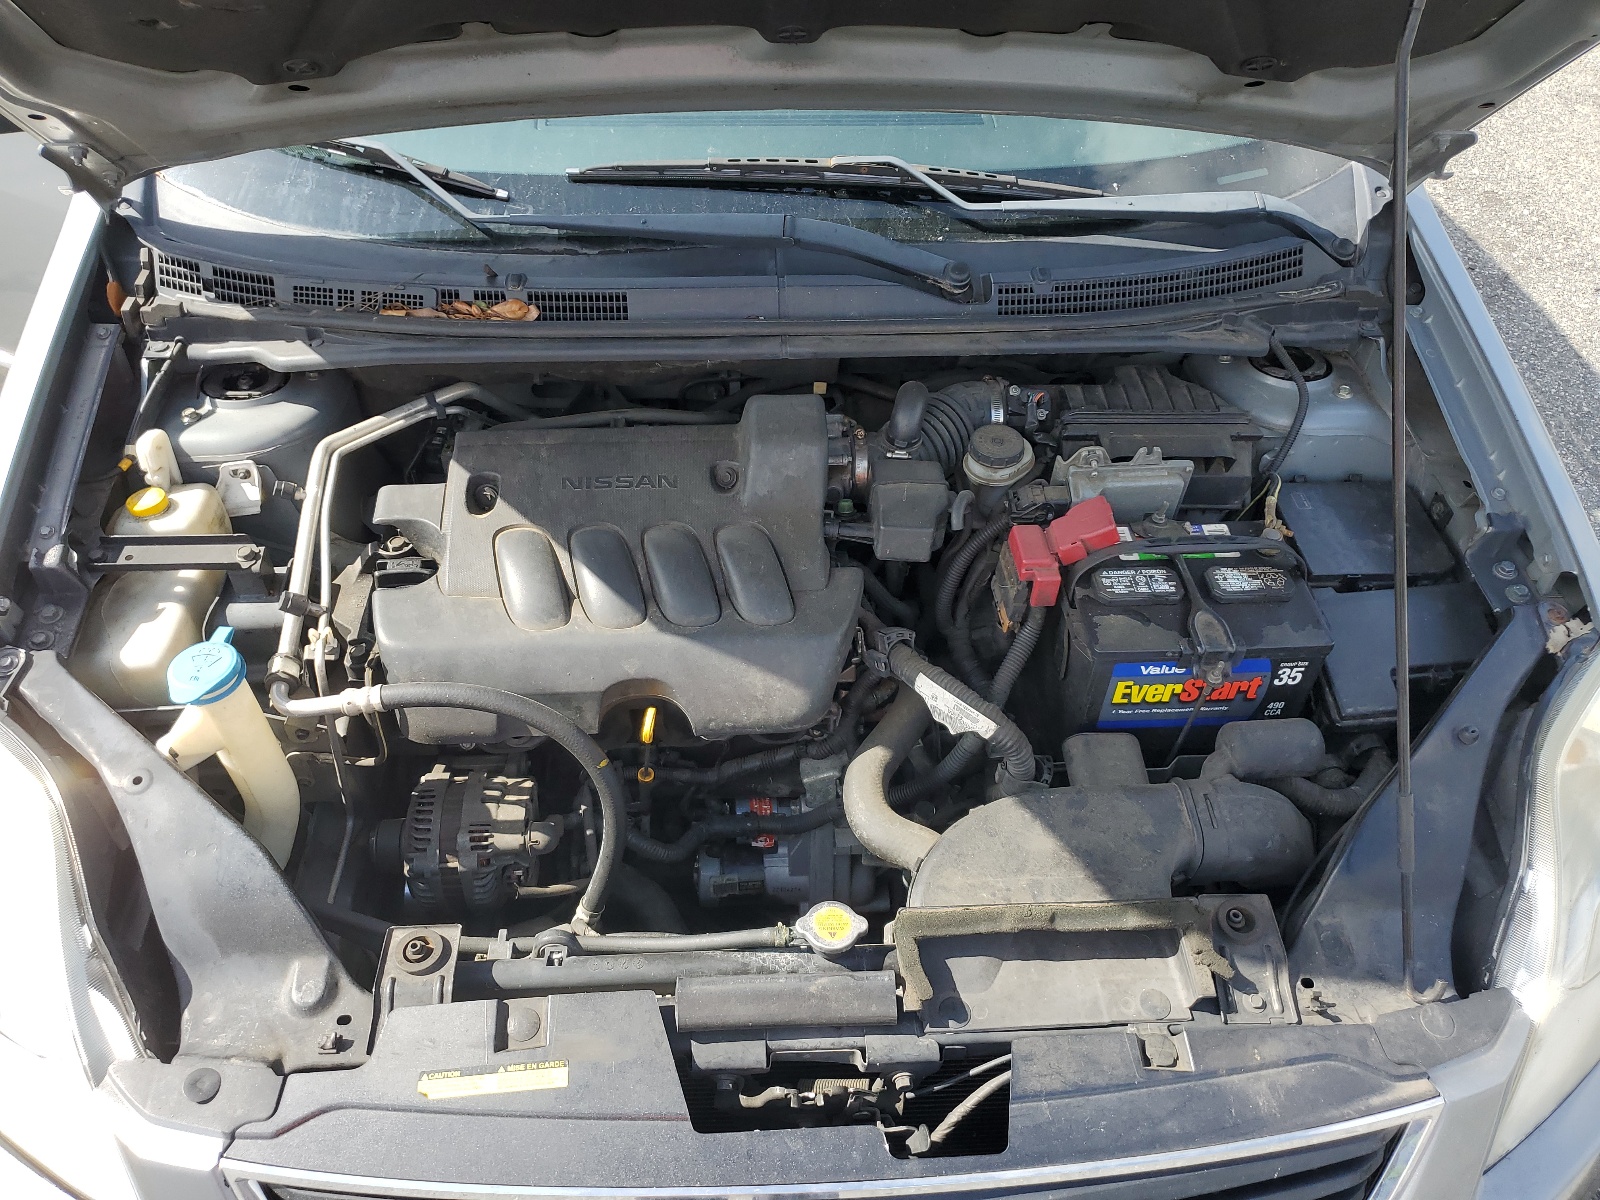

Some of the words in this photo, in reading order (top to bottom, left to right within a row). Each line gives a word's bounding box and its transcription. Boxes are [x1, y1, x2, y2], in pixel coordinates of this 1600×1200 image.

[561, 474, 678, 491] NISSAN
[1140, 664, 1186, 675] Value
[1273, 667, 1305, 686] 35
[1111, 676, 1263, 704] EverSart
[428, 1070, 461, 1080] CAUTION
[527, 1062, 537, 1070] EN
[538, 1060, 565, 1069] GARDE
